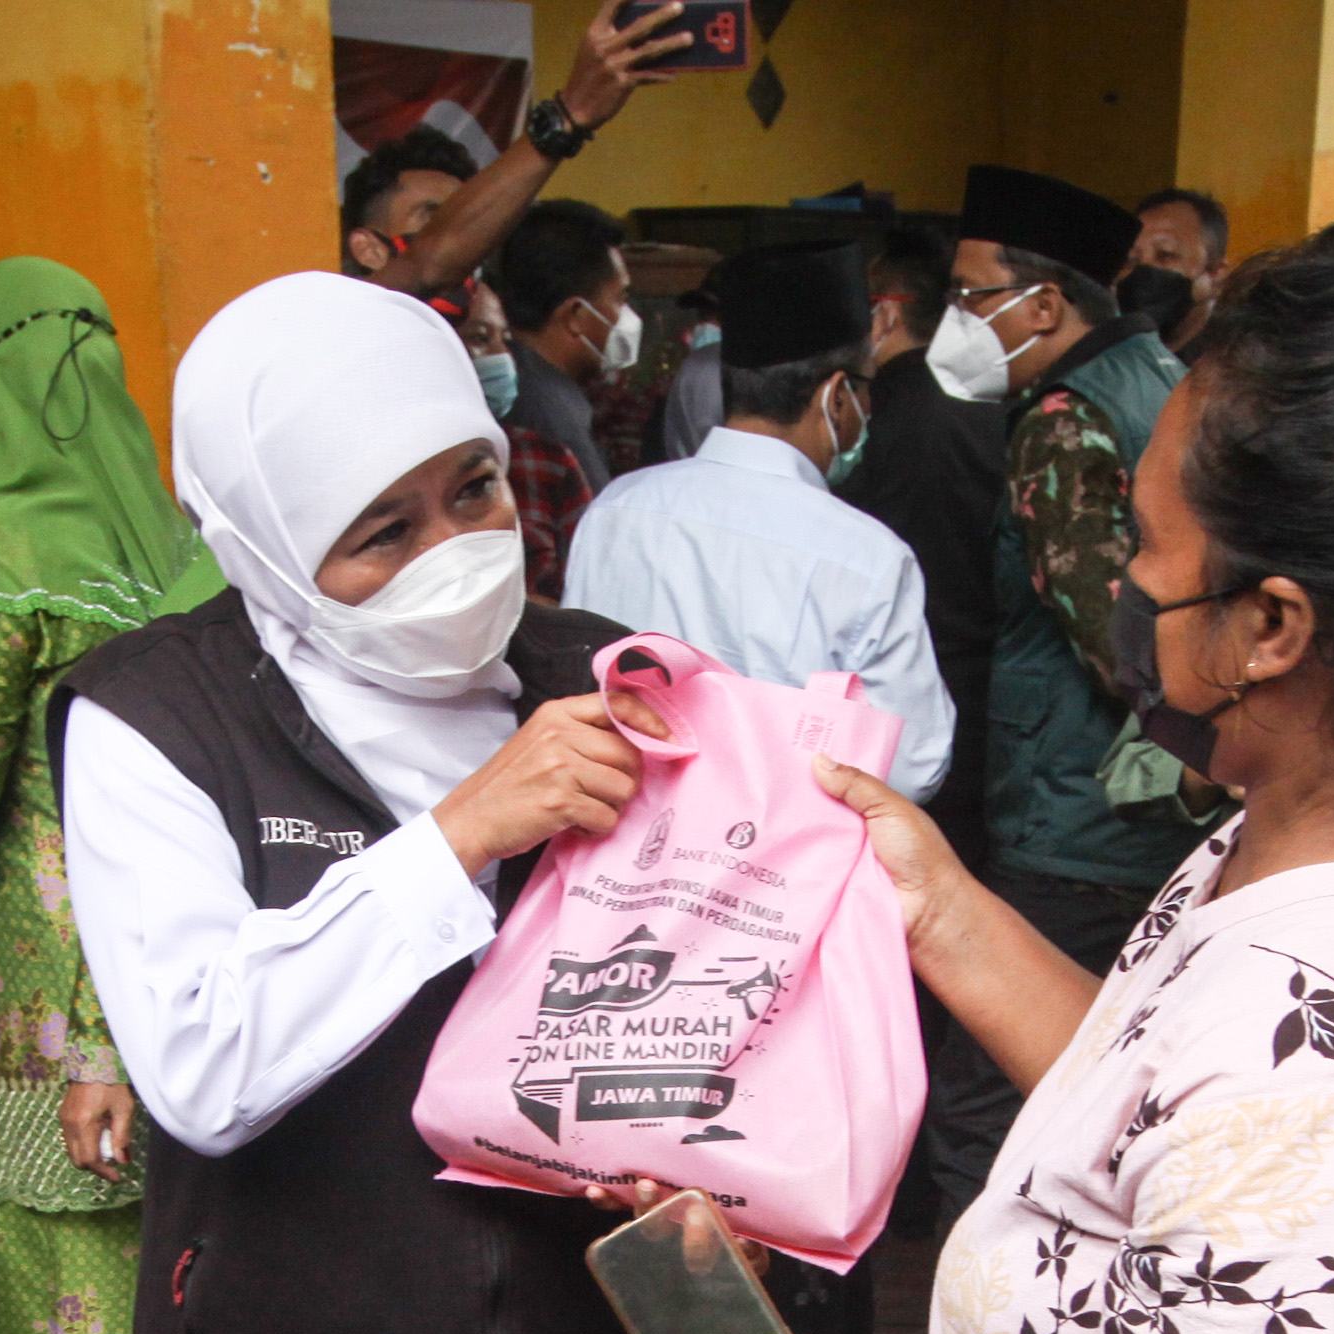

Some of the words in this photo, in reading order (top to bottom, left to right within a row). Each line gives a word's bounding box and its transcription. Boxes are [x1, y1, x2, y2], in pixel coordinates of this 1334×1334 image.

[672, 848, 706, 862] BANK
[709, 851, 788, 889] INDONESIA
[677, 899, 705, 918] DAN
[705, 909, 802, 944] PERDAGANGAN
[706, 889, 740, 909] JAWA
[742, 900, 785, 923] TIMUR
[544, 962, 658, 996] PAMOR
[534, 1015, 612, 1041] PASAR
[621, 1015, 733, 1038] MURAH
[623, 1043, 731, 1062] MANDIRI
[589, 1088, 658, 1106] JAWA
[661, 1087, 725, 1106] TIMUR
